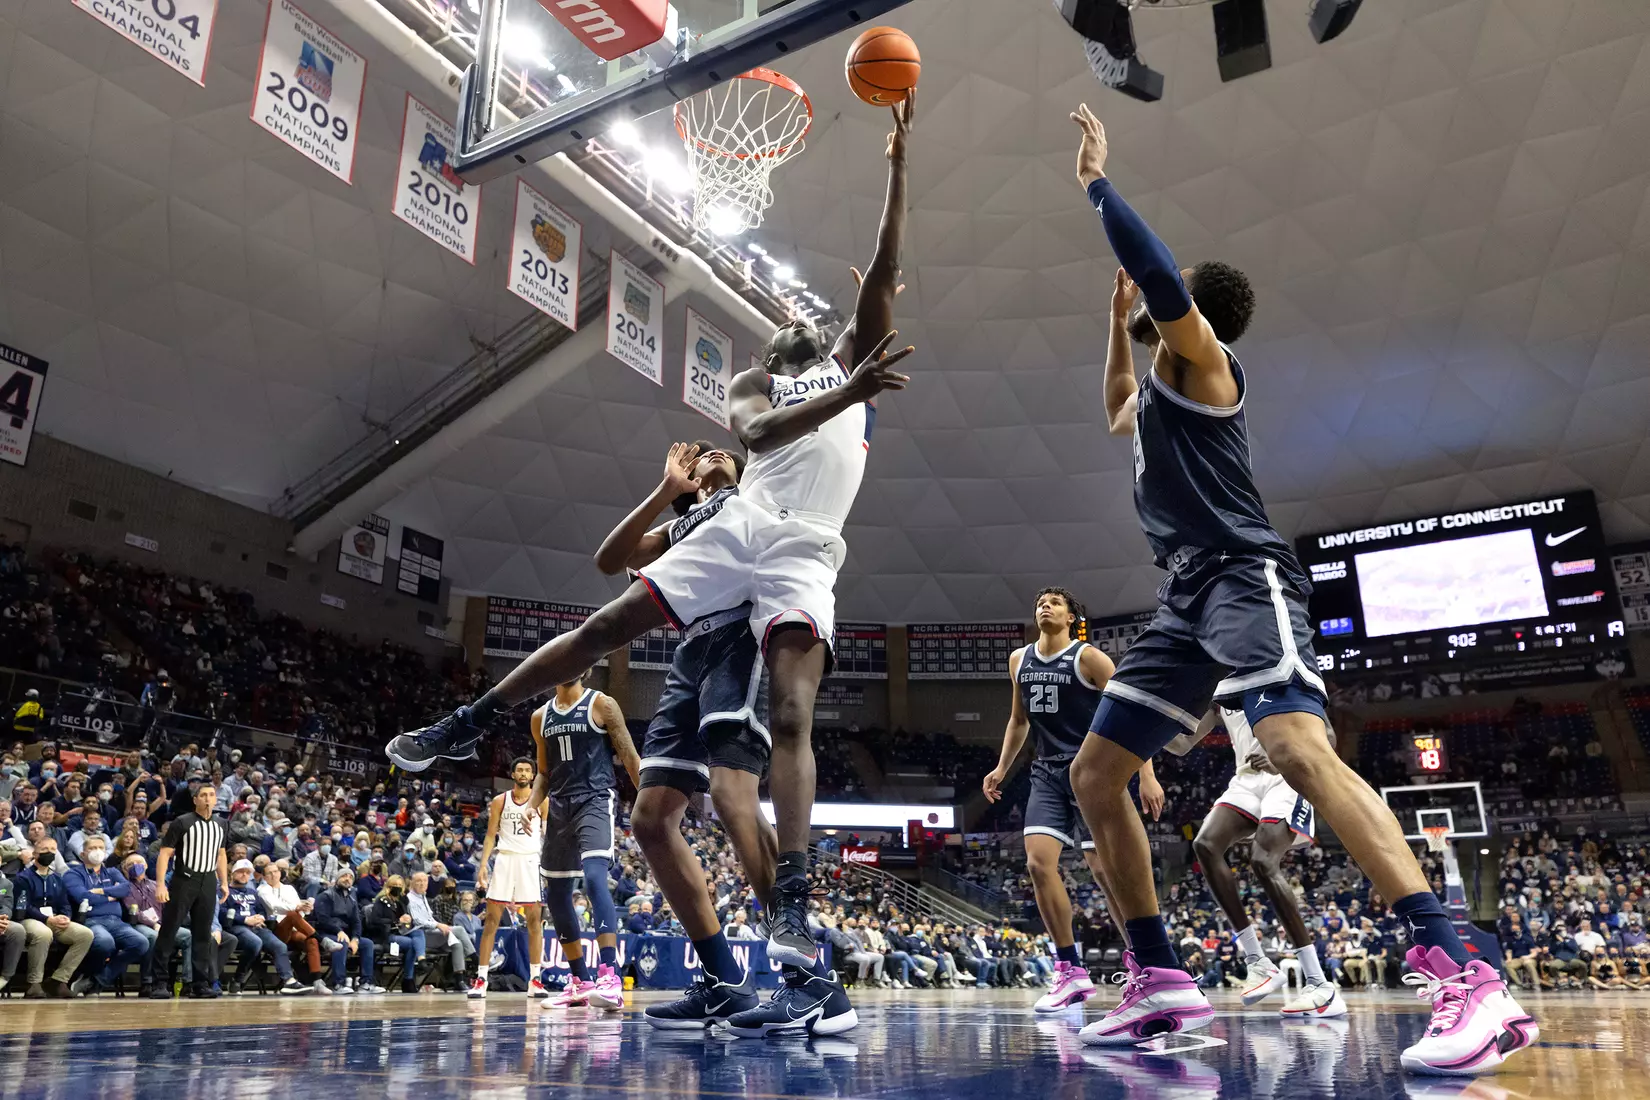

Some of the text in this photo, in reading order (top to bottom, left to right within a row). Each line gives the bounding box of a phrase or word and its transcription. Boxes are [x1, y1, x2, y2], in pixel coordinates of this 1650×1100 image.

[109, 0, 186, 51] ATIONAL
[137, 0, 200, 40] 04
[281, 1, 358, 63] UConn Women's
[92, 1, 191, 71] CHAMPIONS
[294, 22, 343, 65] Basketball
[266, 71, 348, 142] 2009
[414, 102, 442, 128] UConn
[265, 115, 341, 172] CHAMPIONS
[273, 103, 337, 155] NATIONAL
[408, 170, 469, 225] 2010
[404, 208, 466, 255] CHAMPIONS
[410, 197, 463, 239] NATIONAL
[533, 202, 567, 231] Basketball
[521, 249, 570, 295] 2013
[516, 283, 569, 323] CHAMPIONS
[521, 273, 566, 309] NATIONAL
[616, 313, 656, 354] 2014
[613, 345, 657, 378] CHAMPIONS
[616, 335, 655, 366] NATIONAL
[690, 366, 725, 402] 2015
[688, 396, 727, 425] CHAMPIONS
[691, 387, 724, 413] NATIONAL
[674, 501, 726, 540] GEORGETO
[1318, 498, 1566, 549] UNIVERSITY OF CONNECTICUT
[1309, 560, 1347, 573] WELLS
[1311, 569, 1348, 582] FARGO
[1620, 569, 1646, 585] 52
[489, 598, 508, 606] BIG
[512, 600, 540, 609] EAST
[489, 605, 527, 615] REGULAR
[529, 609, 561, 619] SEASON
[701, 620, 711, 632] G
[913, 624, 1019, 633] NCAA CHAMPIONSHIP
[1320, 617, 1349, 630] CBS
[1020, 672, 1072, 685] GEORGETOWN
[1029, 684, 1059, 713] 23
[61, 714, 115, 733] SEC 109
[544, 723, 588, 738] GEORGETOWN
[557, 735, 573, 762] 11
[1420, 749, 1441, 770] 18
[328, 759, 365, 773] SEC 109
[512, 821, 526, 835] 12
